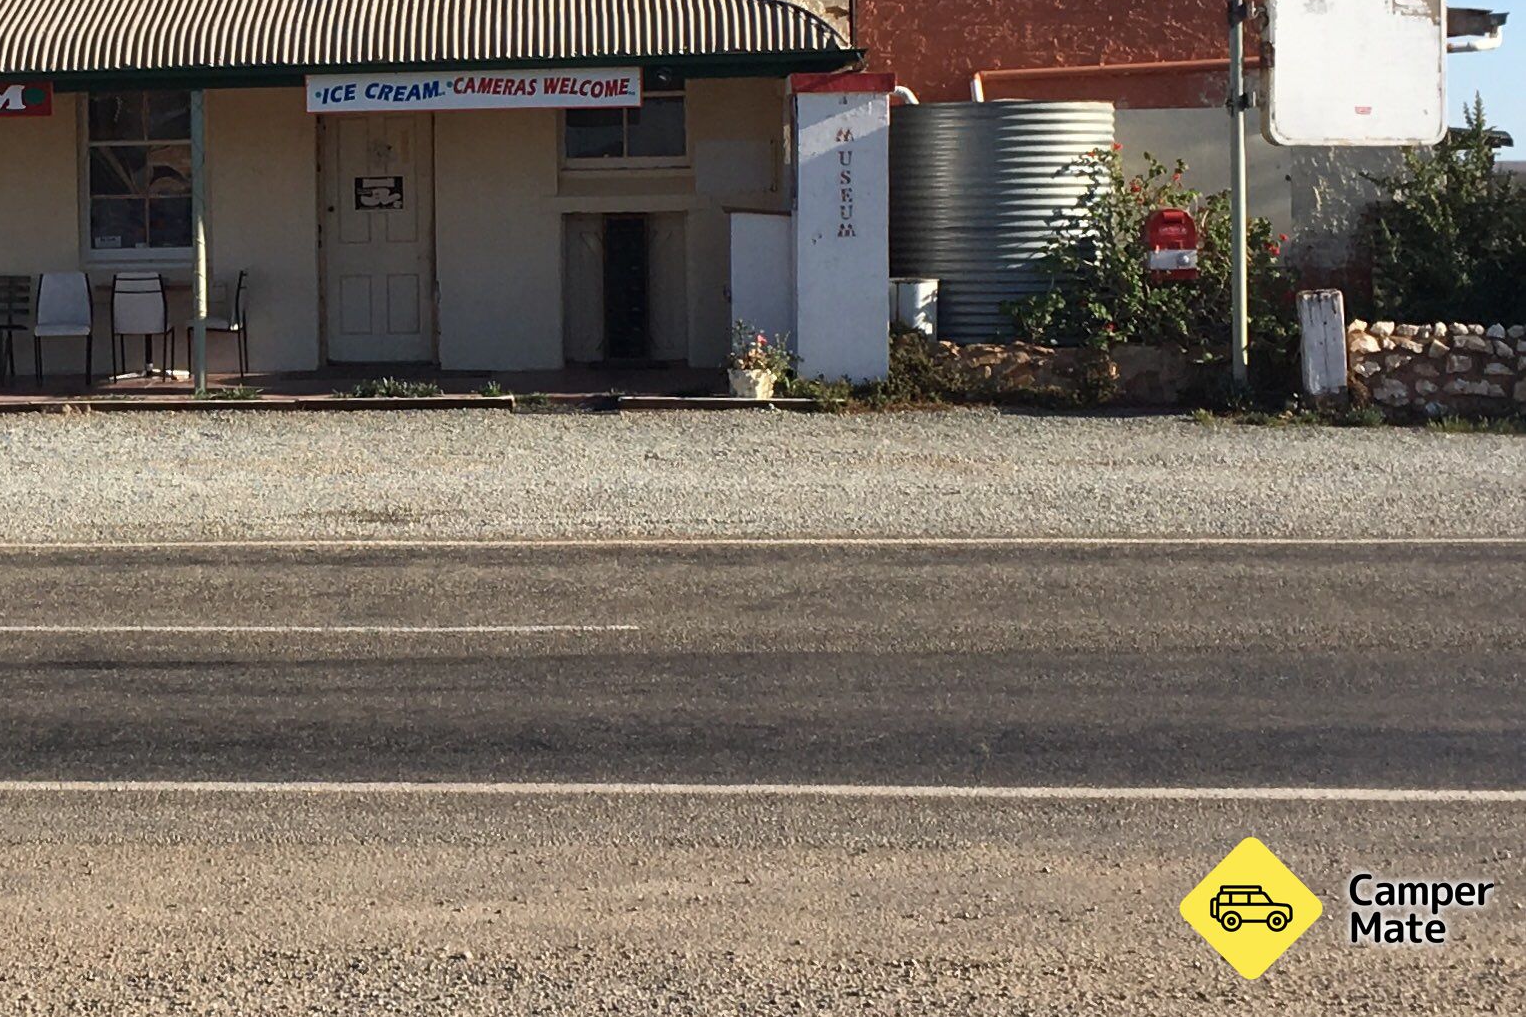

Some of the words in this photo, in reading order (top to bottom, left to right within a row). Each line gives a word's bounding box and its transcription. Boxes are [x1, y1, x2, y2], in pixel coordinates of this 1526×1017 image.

[322, 83, 356, 104] ICE
[365, 80, 440, 102] CREAM
[453, 77, 537, 96] CAMERAS
[543, 77, 630, 98] WELCOME
[836, 127, 856, 238] MUSEUM
